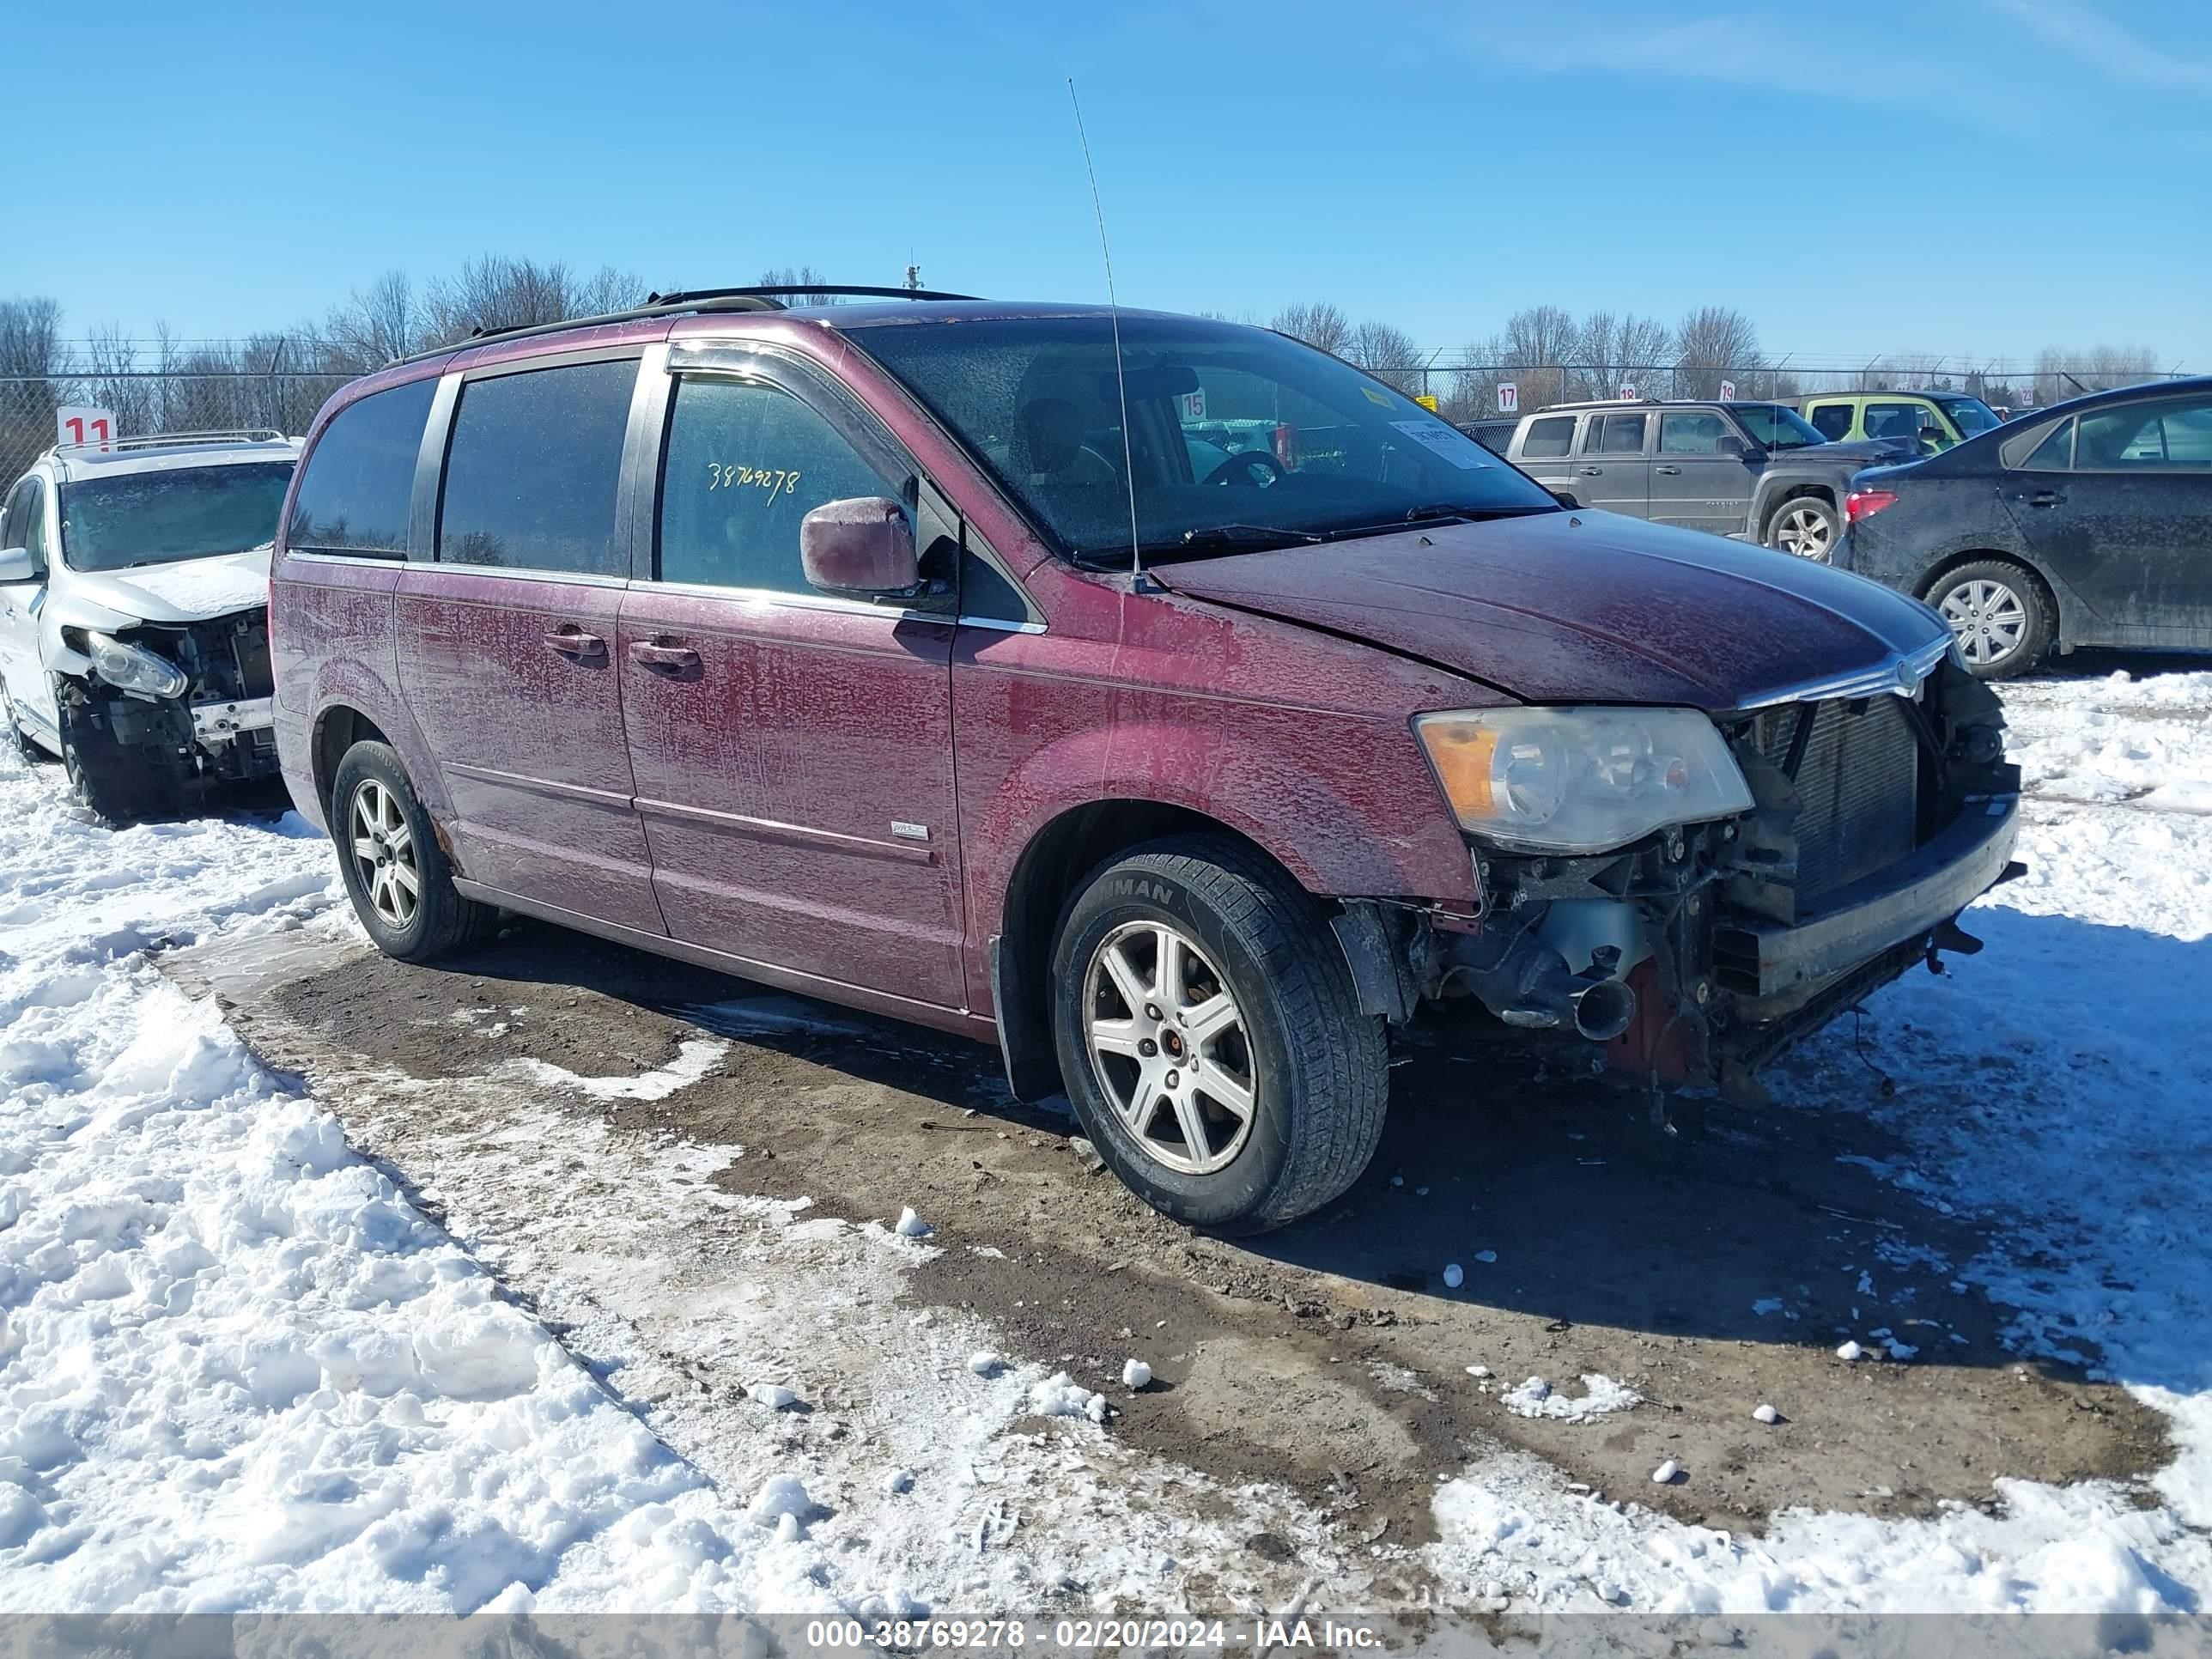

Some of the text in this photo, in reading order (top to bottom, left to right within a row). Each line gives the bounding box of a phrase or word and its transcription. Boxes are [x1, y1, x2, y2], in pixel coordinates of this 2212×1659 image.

[1500, 388, 1515, 407] 17
[1722, 386, 1734, 401] 19
[1184, 394, 1203, 416] 15
[65, 417, 109, 453] 11
[708, 463, 801, 507] 38769278
